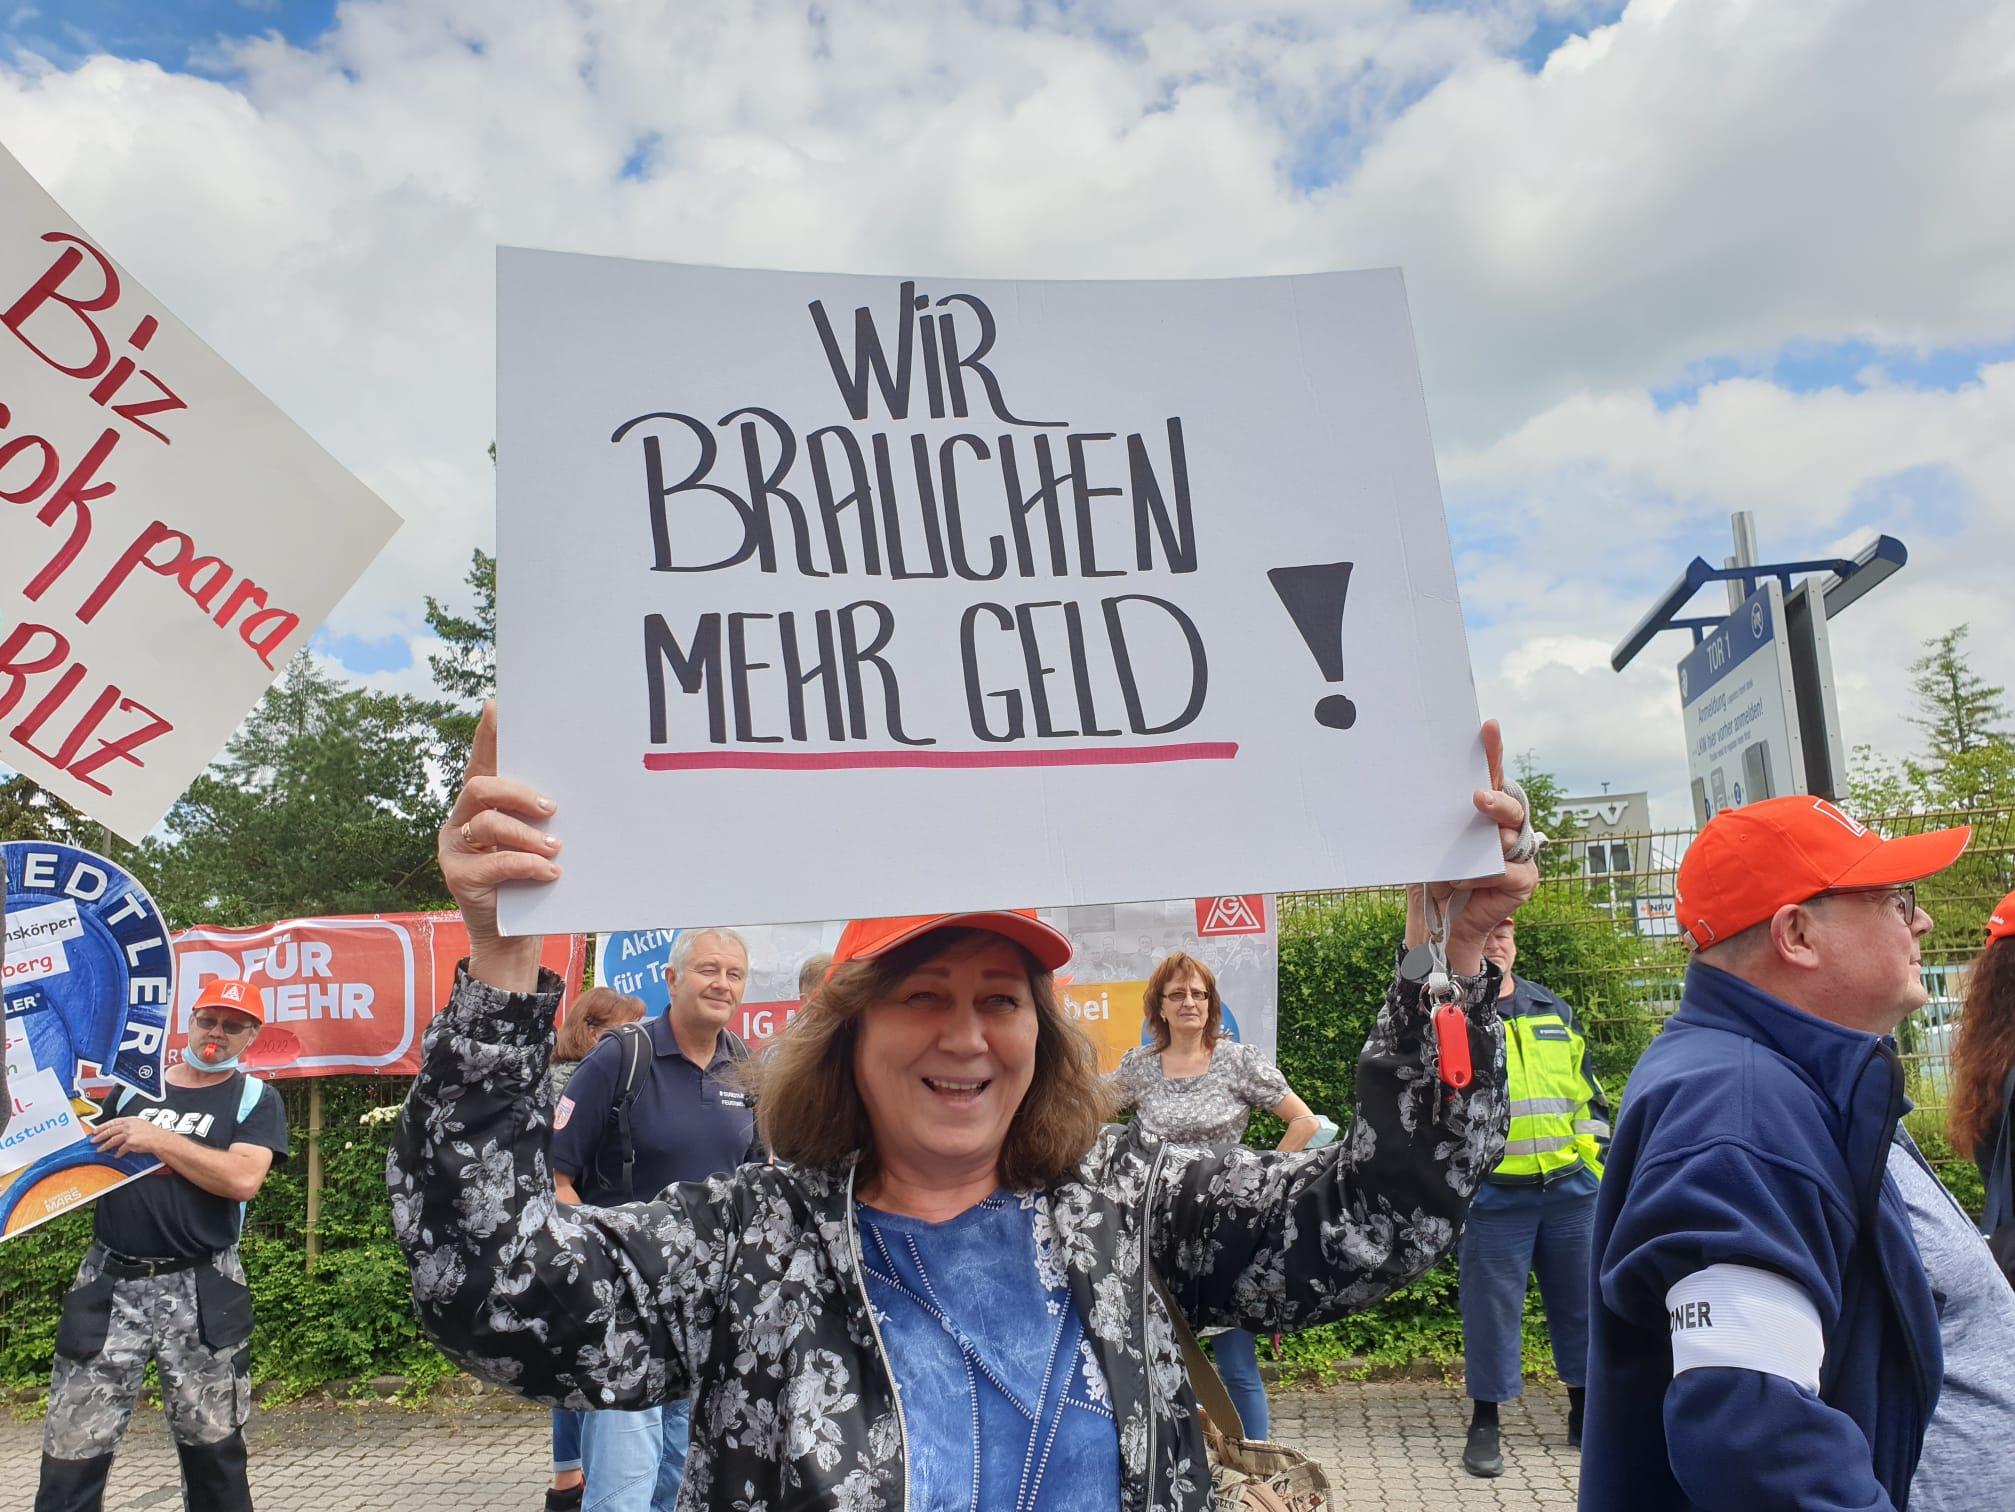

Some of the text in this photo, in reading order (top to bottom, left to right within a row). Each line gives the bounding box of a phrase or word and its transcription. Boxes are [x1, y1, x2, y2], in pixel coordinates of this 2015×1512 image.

[0, 232, 188, 446] Biz
[611, 406, 1198, 582] BRAUCHEN
[0, 402, 299, 672] ok para
[643, 600, 936, 746] MEHR
[960, 594, 1208, 744] GELD
[1707, 636, 1725, 675] TOR
[4, 853, 168, 1056] EDTLER
[242, 933, 333, 984] FÜR
[621, 929, 674, 961] Aktiv
[613, 972, 644, 995] für
[742, 1010, 774, 1040] IG
[138, 1107, 215, 1138] FREI
